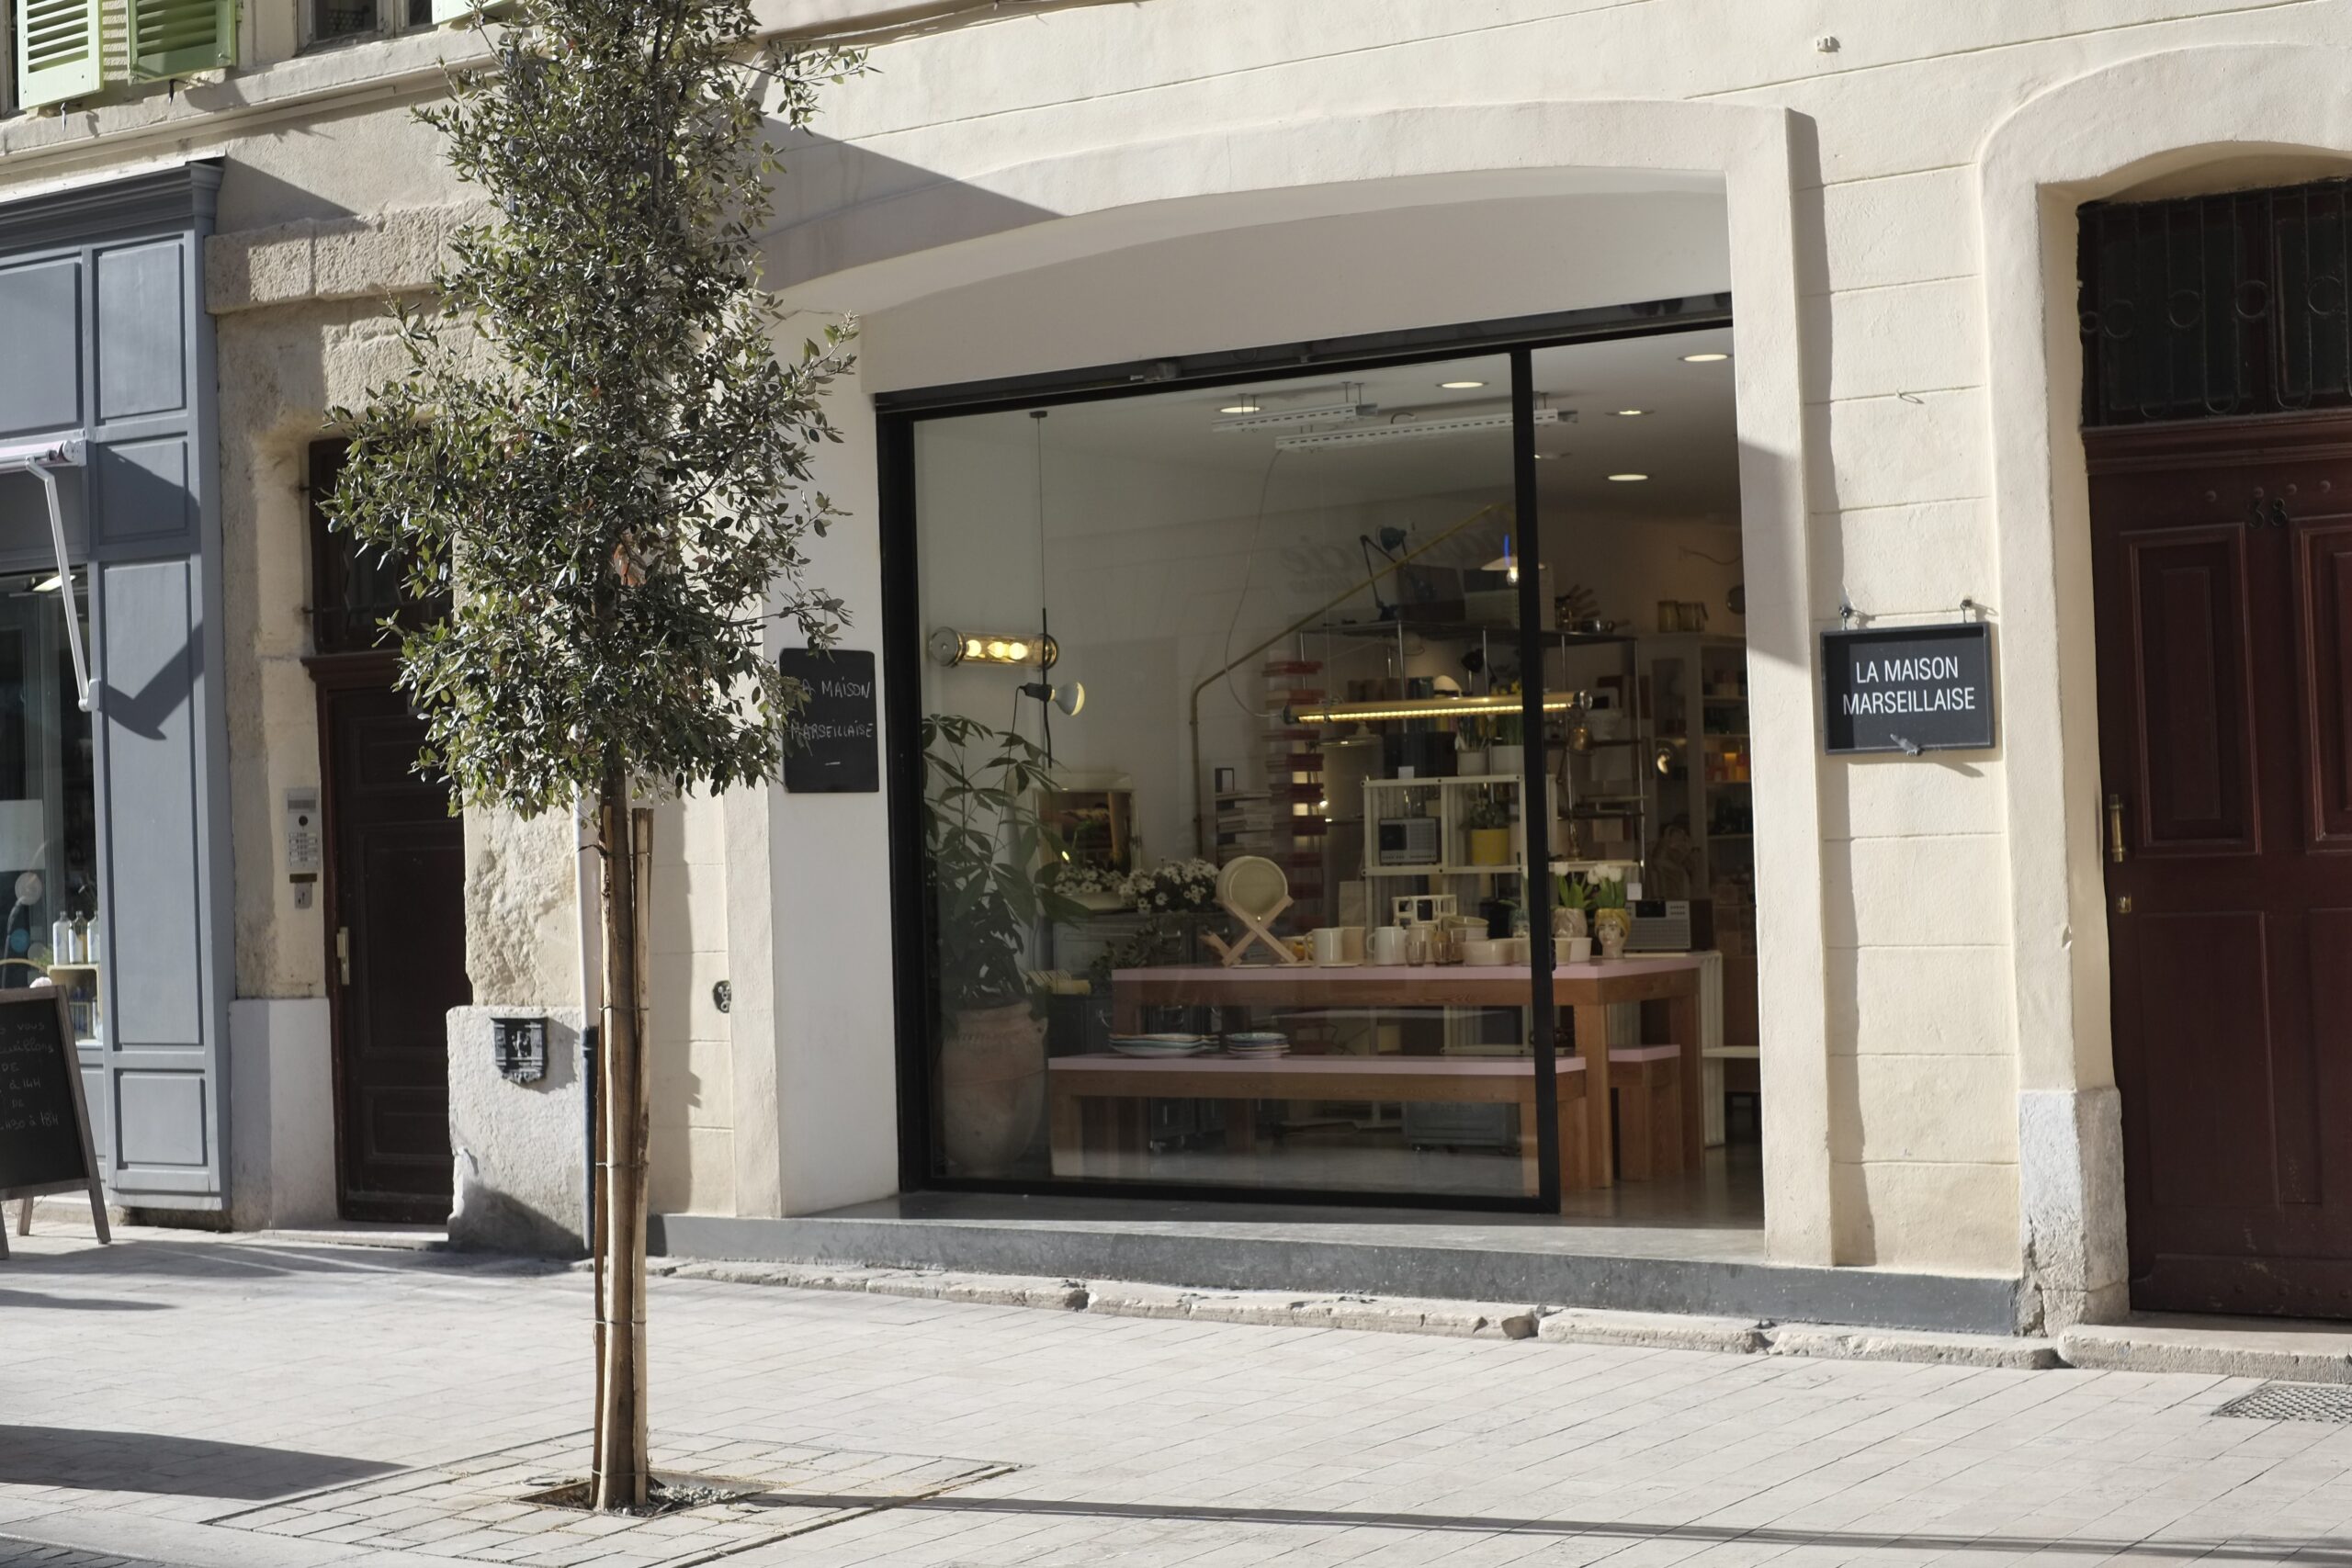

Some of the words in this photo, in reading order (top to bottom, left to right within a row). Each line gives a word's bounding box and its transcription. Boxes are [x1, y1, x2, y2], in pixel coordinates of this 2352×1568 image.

[1856, 660, 1879, 683] LA
[1884, 656, 1959, 682] MAISON
[1843, 687, 1975, 716] MARSEILLAISE
